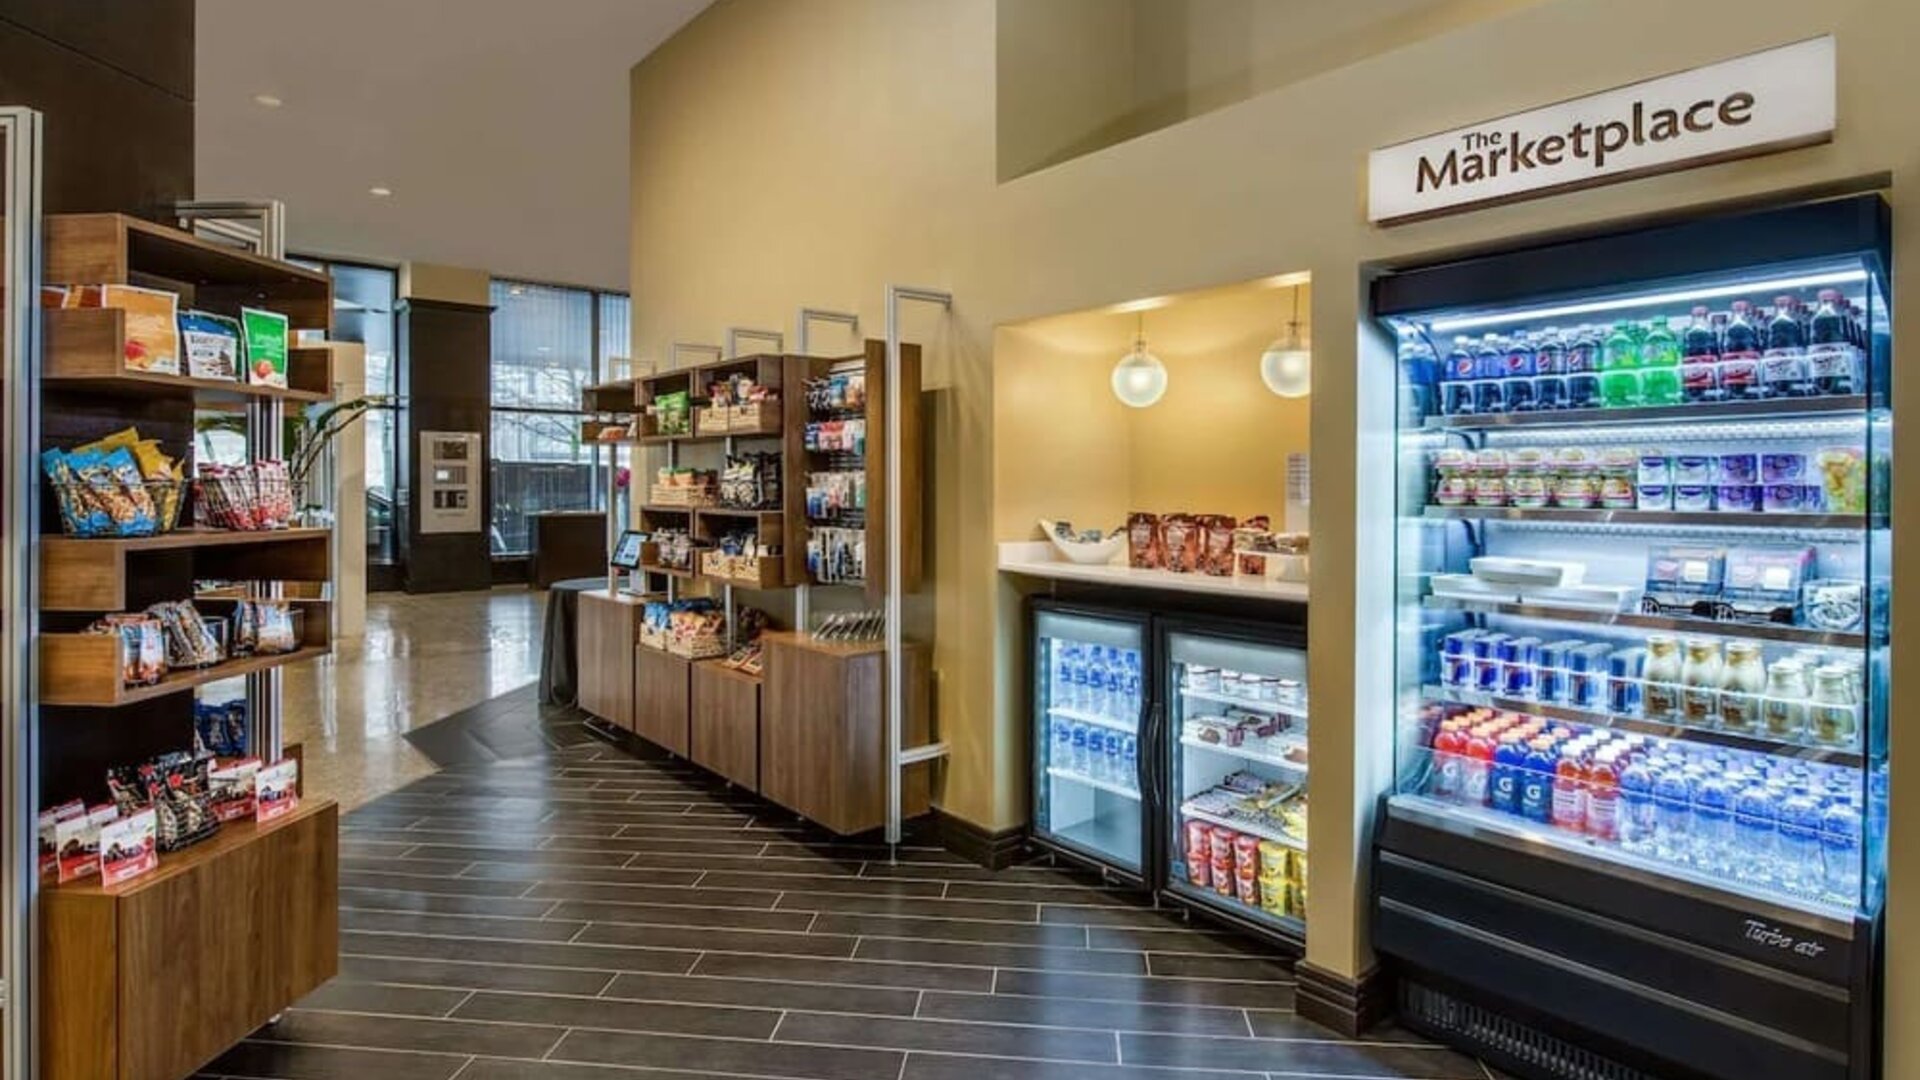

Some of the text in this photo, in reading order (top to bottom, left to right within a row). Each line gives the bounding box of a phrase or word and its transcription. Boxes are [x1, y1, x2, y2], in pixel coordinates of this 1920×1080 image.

[1416, 92, 1755, 192] Marketplace
[1463, 131, 1502, 150] The
[1499, 777, 1513, 792] G
[1526, 784, 1541, 800] G
[1745, 920, 1825, 957] Turbo air
